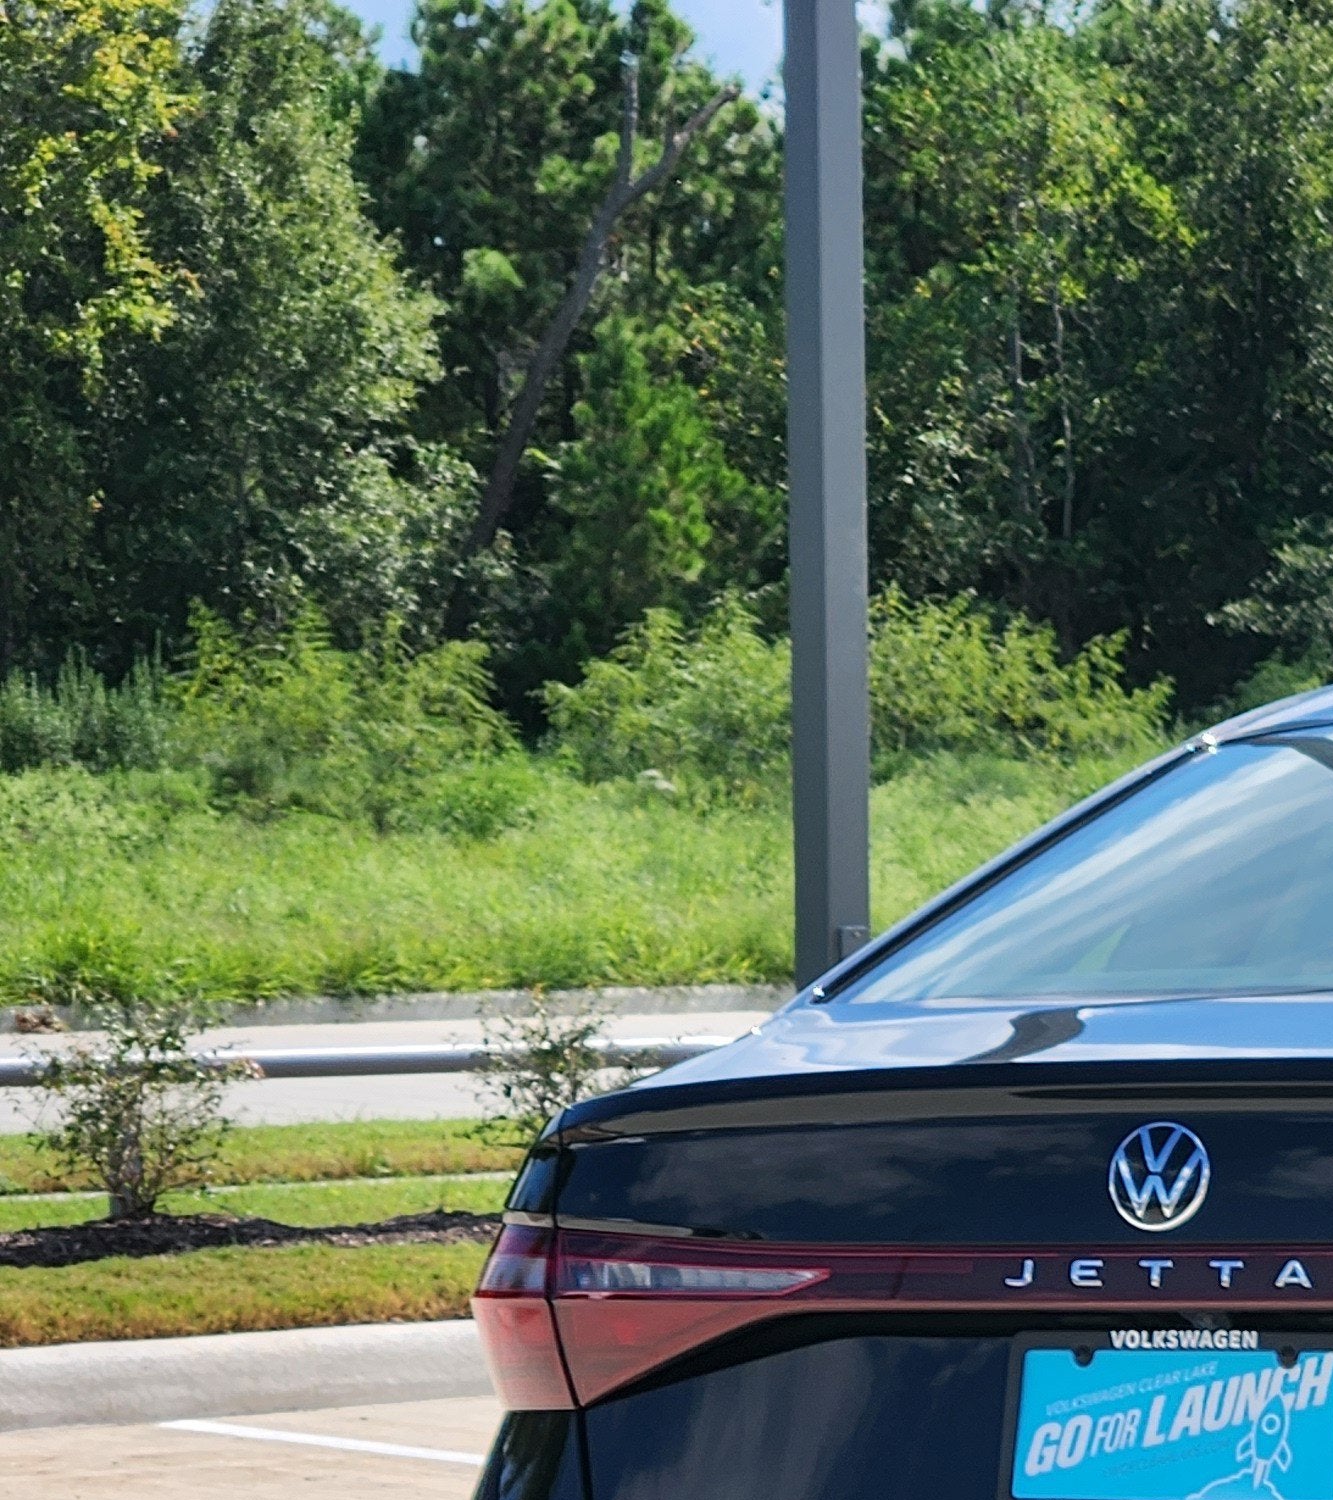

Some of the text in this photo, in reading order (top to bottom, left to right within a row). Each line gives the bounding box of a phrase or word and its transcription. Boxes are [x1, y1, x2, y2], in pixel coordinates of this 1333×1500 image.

[1004, 1258, 1314, 1289] JETTA
[1110, 1329, 1260, 1350] VOLKSWAGEN
[1138, 1369, 1182, 1393] CLEAR
[1182, 1360, 1219, 1382] LAKE
[1023, 1413, 1094, 1478] GO
[1090, 1408, 1142, 1458] FOR
